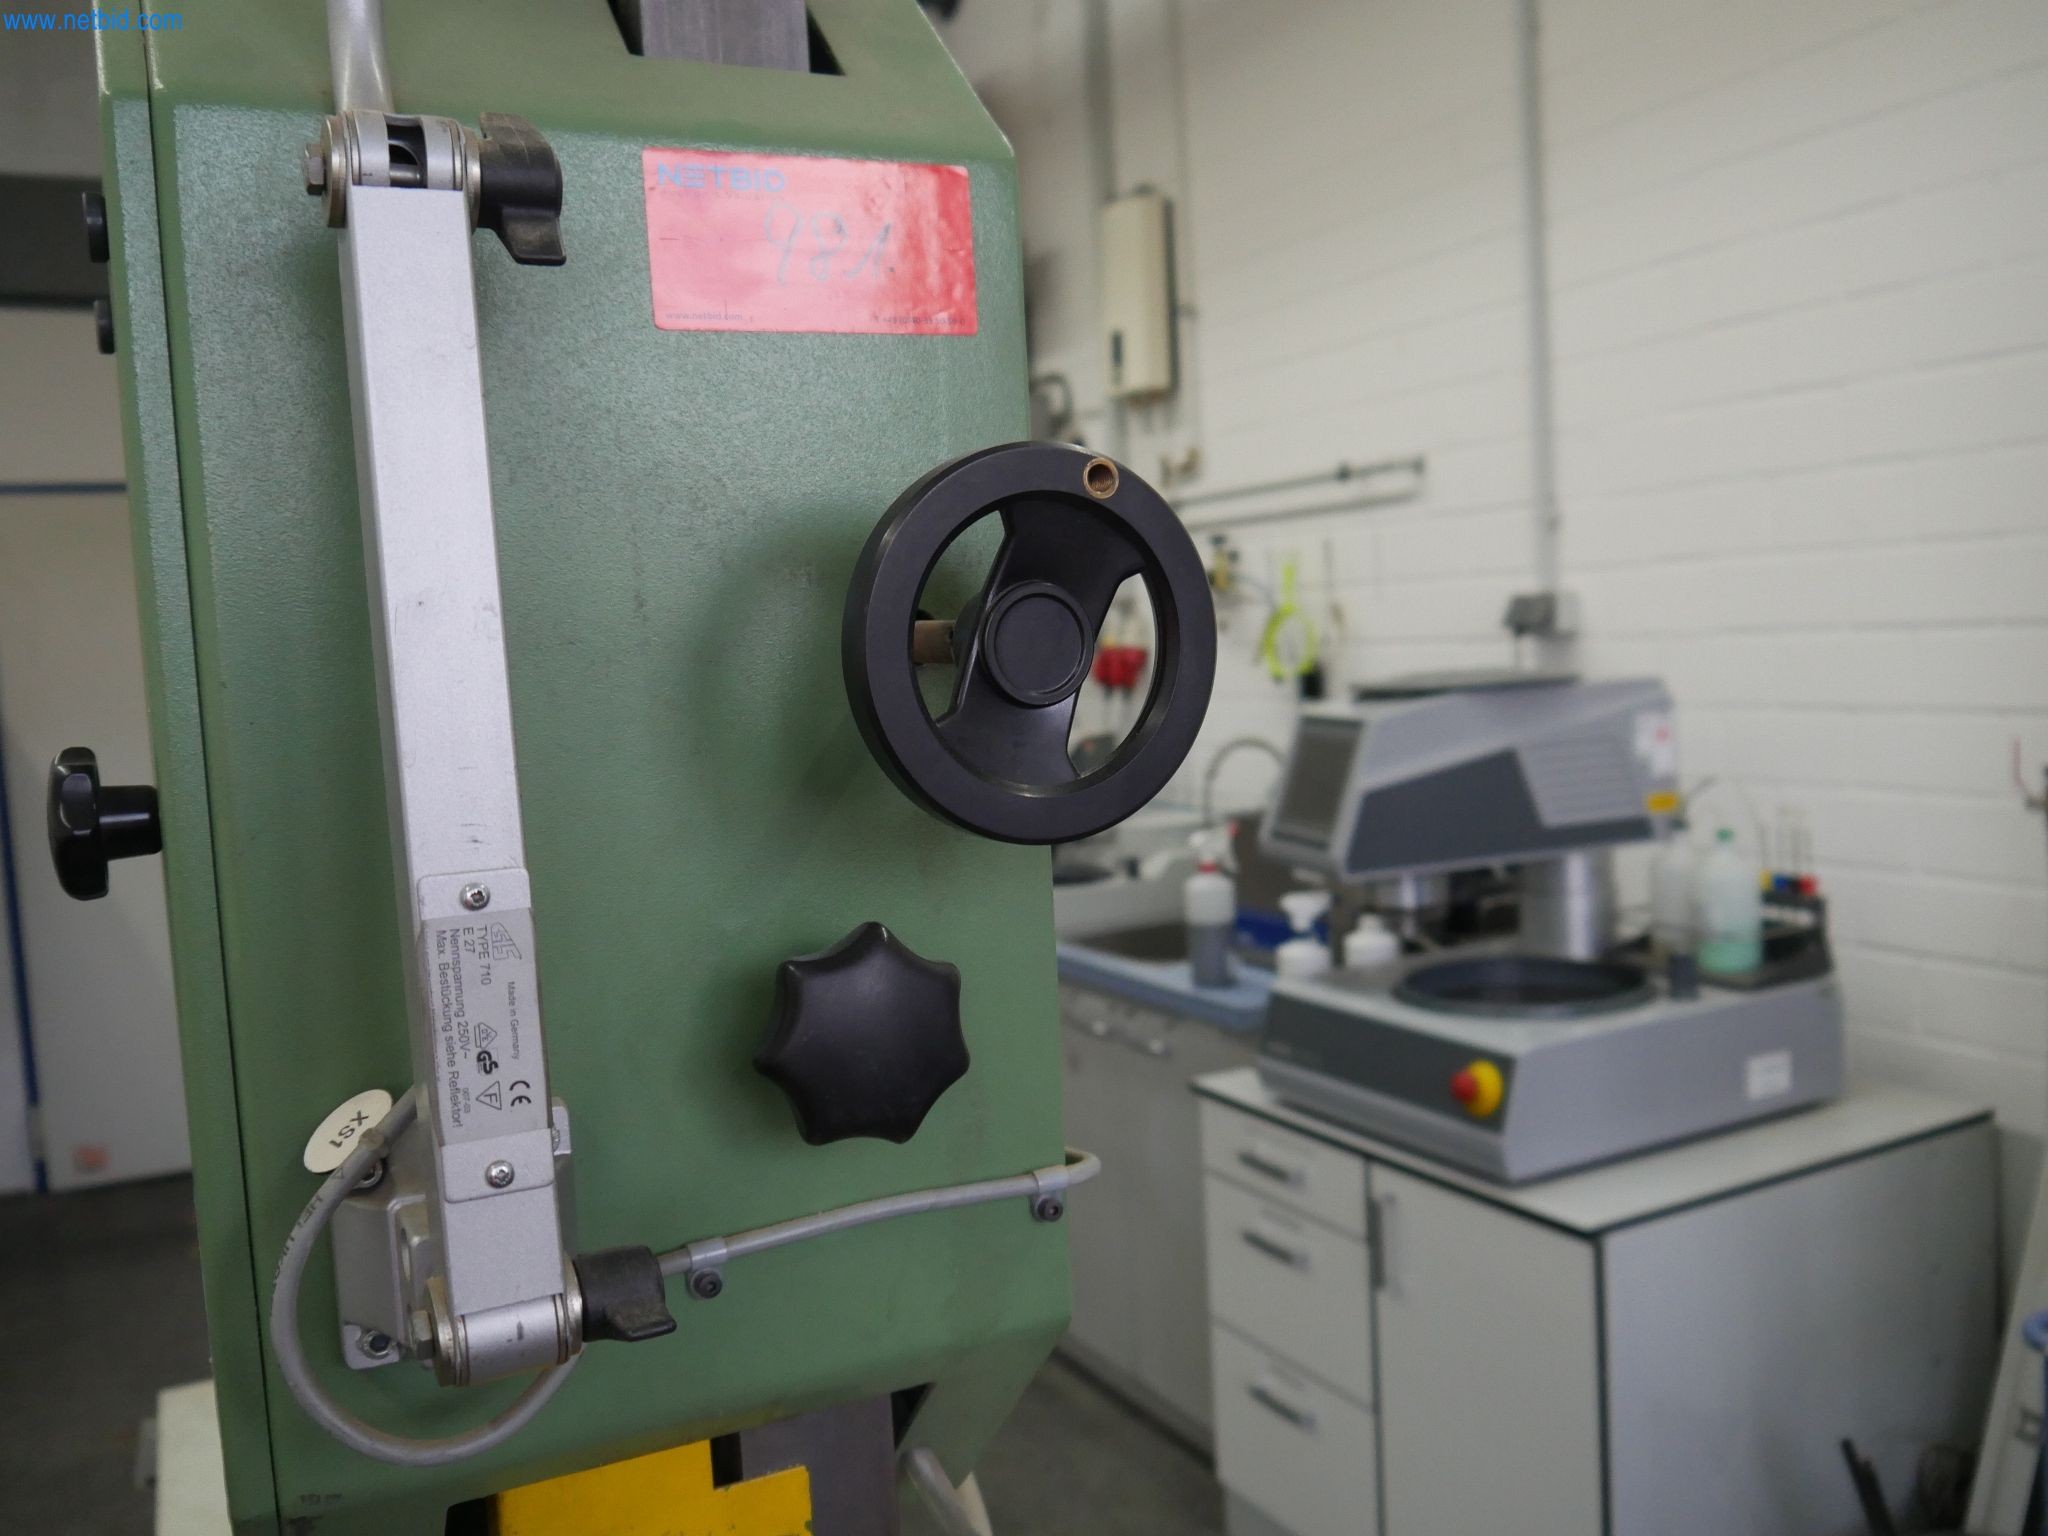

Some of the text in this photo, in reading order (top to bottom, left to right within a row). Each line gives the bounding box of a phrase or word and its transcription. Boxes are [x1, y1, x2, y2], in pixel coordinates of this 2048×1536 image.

[657, 161, 785, 192] NETBID
[463, 926, 476, 953] E 27
[477, 924, 492, 985] TYPE 710
[449, 928, 465, 1018] Nennspannung
[436, 930, 463, 1128] Max. Bestückung siehe Reflektor!
[508, 981, 520, 1060] Made in Germany
[477, 1050, 499, 1075] GS
[329, 1109, 369, 1148] XS1
